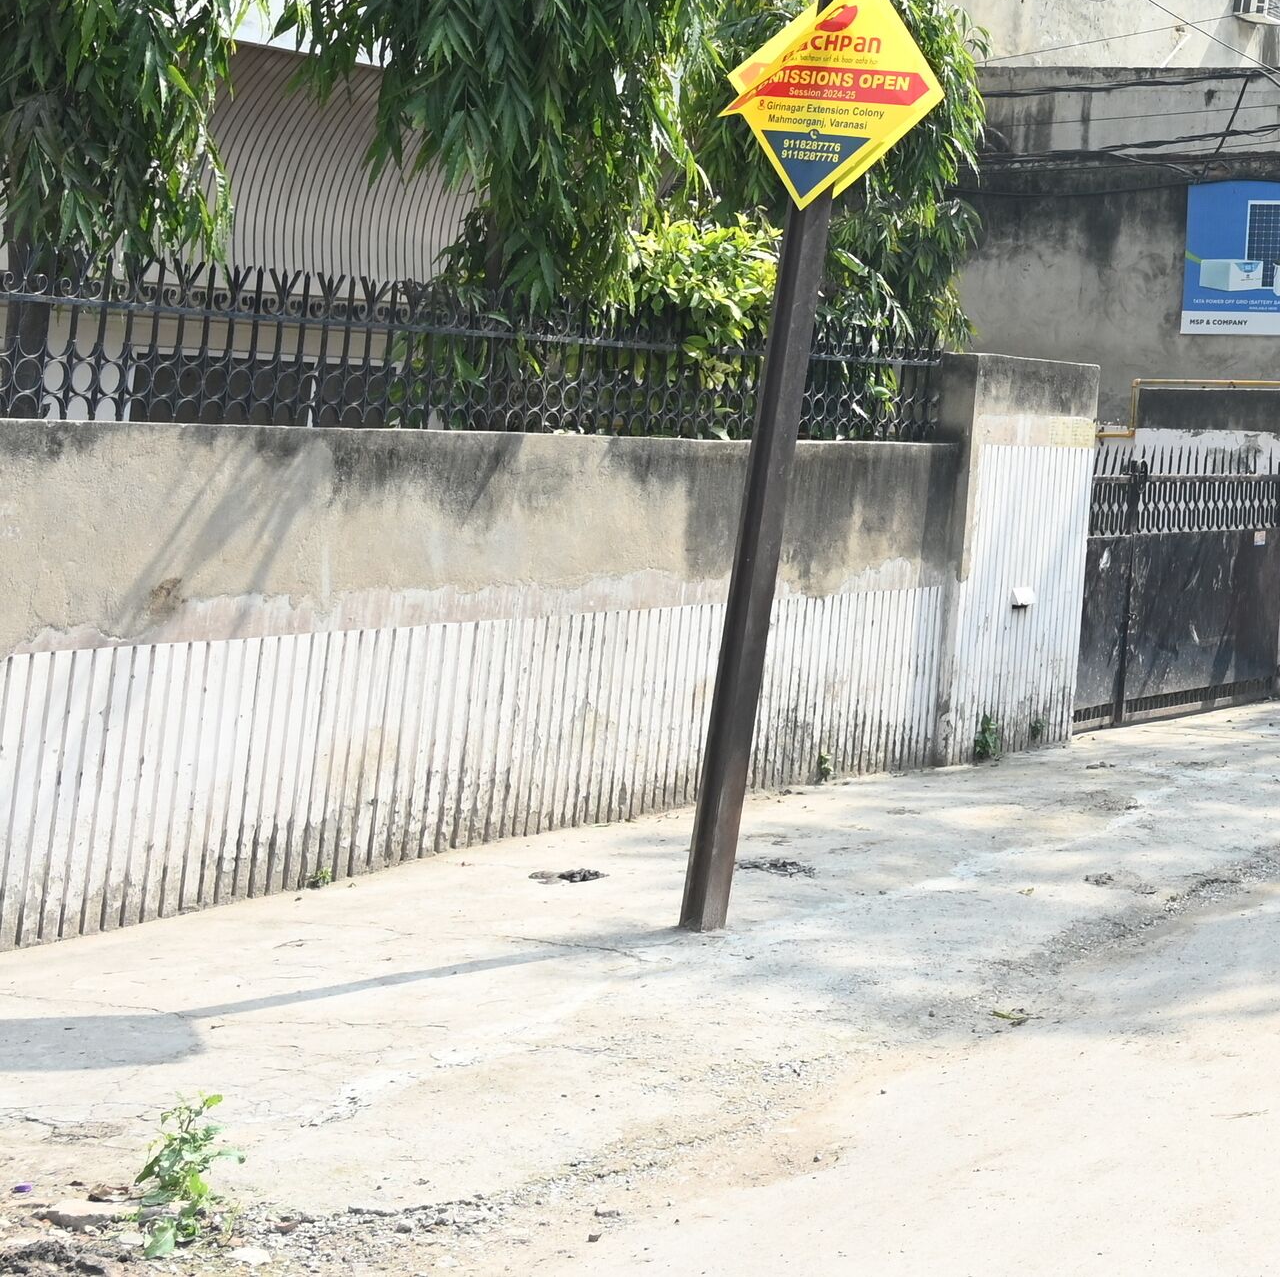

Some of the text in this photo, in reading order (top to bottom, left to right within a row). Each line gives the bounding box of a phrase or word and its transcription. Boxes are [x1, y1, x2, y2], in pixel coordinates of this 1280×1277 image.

[858, 73, 910, 91] OPEN
[789, 86, 856, 100] Session 2024-25
[767, 101, 884, 120] Girinagar Extension Colony
[768, 114, 867, 130] Mahmoorganj, Varanasi
[783, 138, 841, 152] 9118287776
[781, 149, 839, 163] 9118287778
